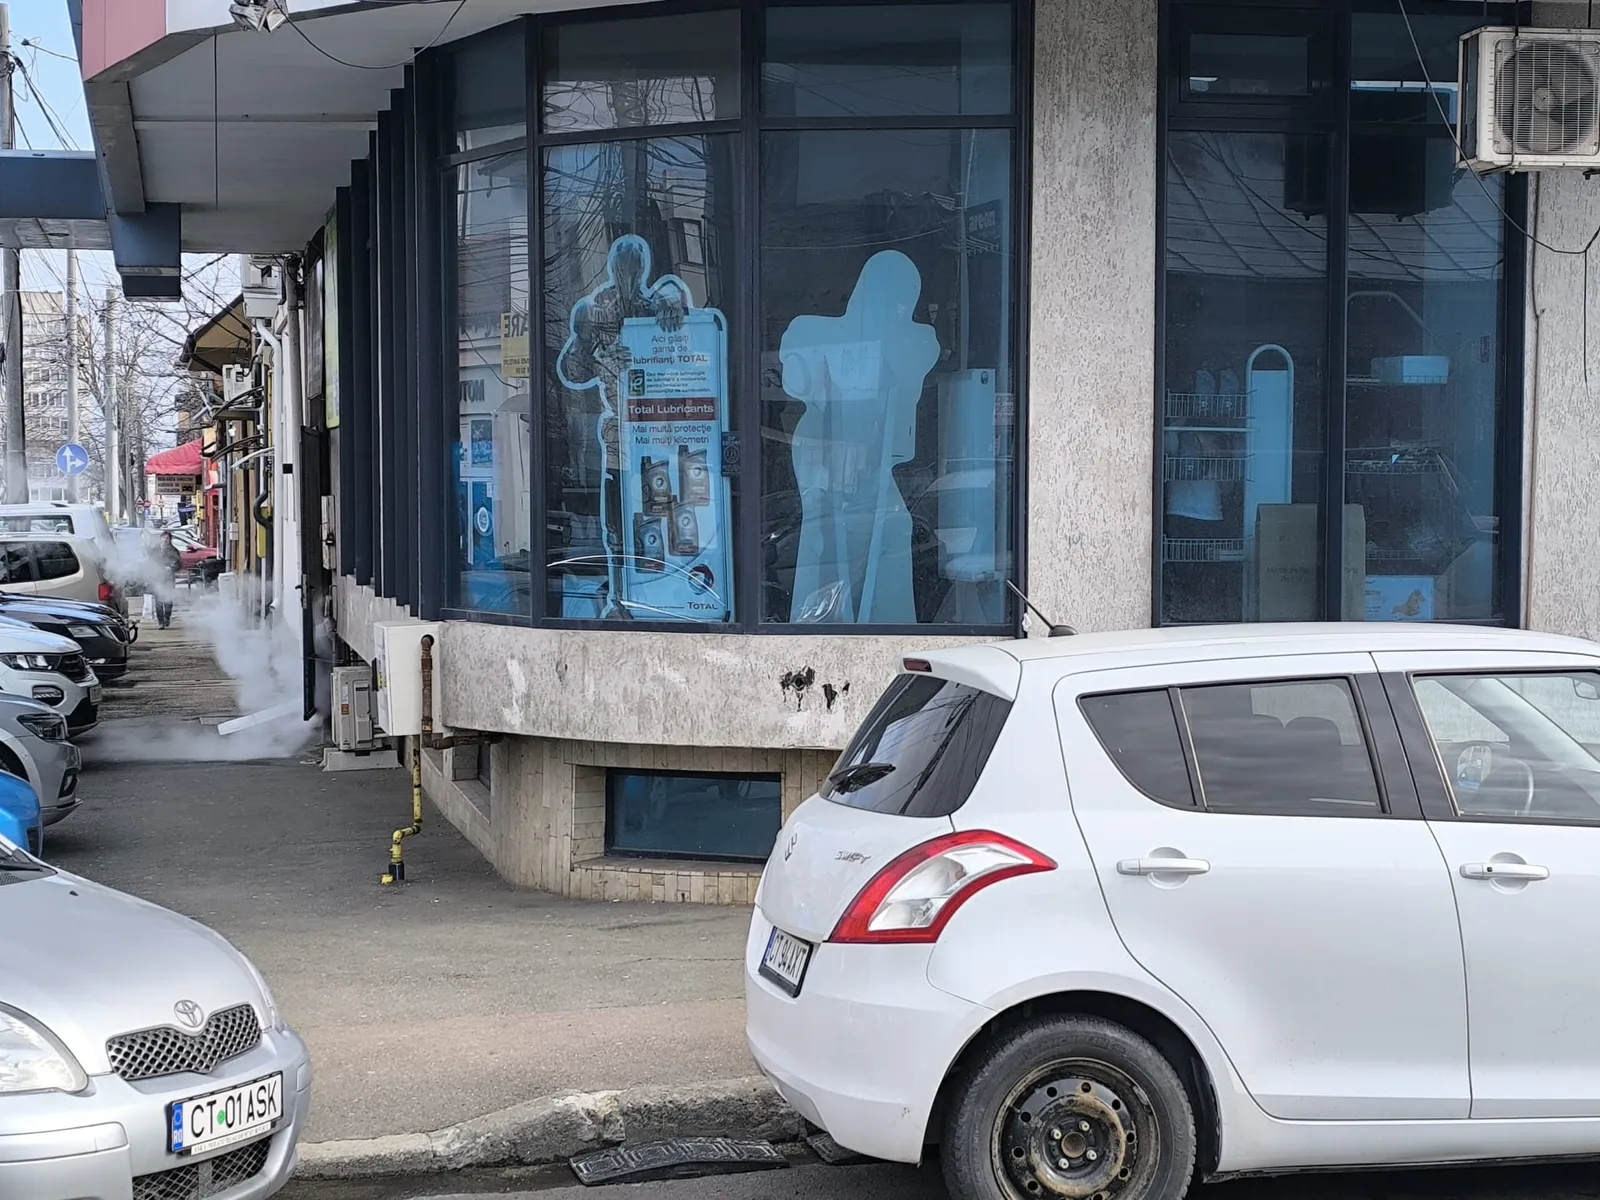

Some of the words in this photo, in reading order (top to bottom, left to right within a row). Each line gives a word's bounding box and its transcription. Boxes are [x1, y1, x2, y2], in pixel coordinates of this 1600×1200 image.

[652, 346, 676, 354] gama
[677, 344, 688, 352] de
[677, 354, 709, 363] TOTAL
[628, 404, 655, 414] Total
[657, 403, 714, 414] Lubricants
[632, 424, 647, 433] Mai
[635, 436, 650, 444] Mai
[674, 436, 710, 444] kilometri
[191, 1100, 217, 1138] CT
